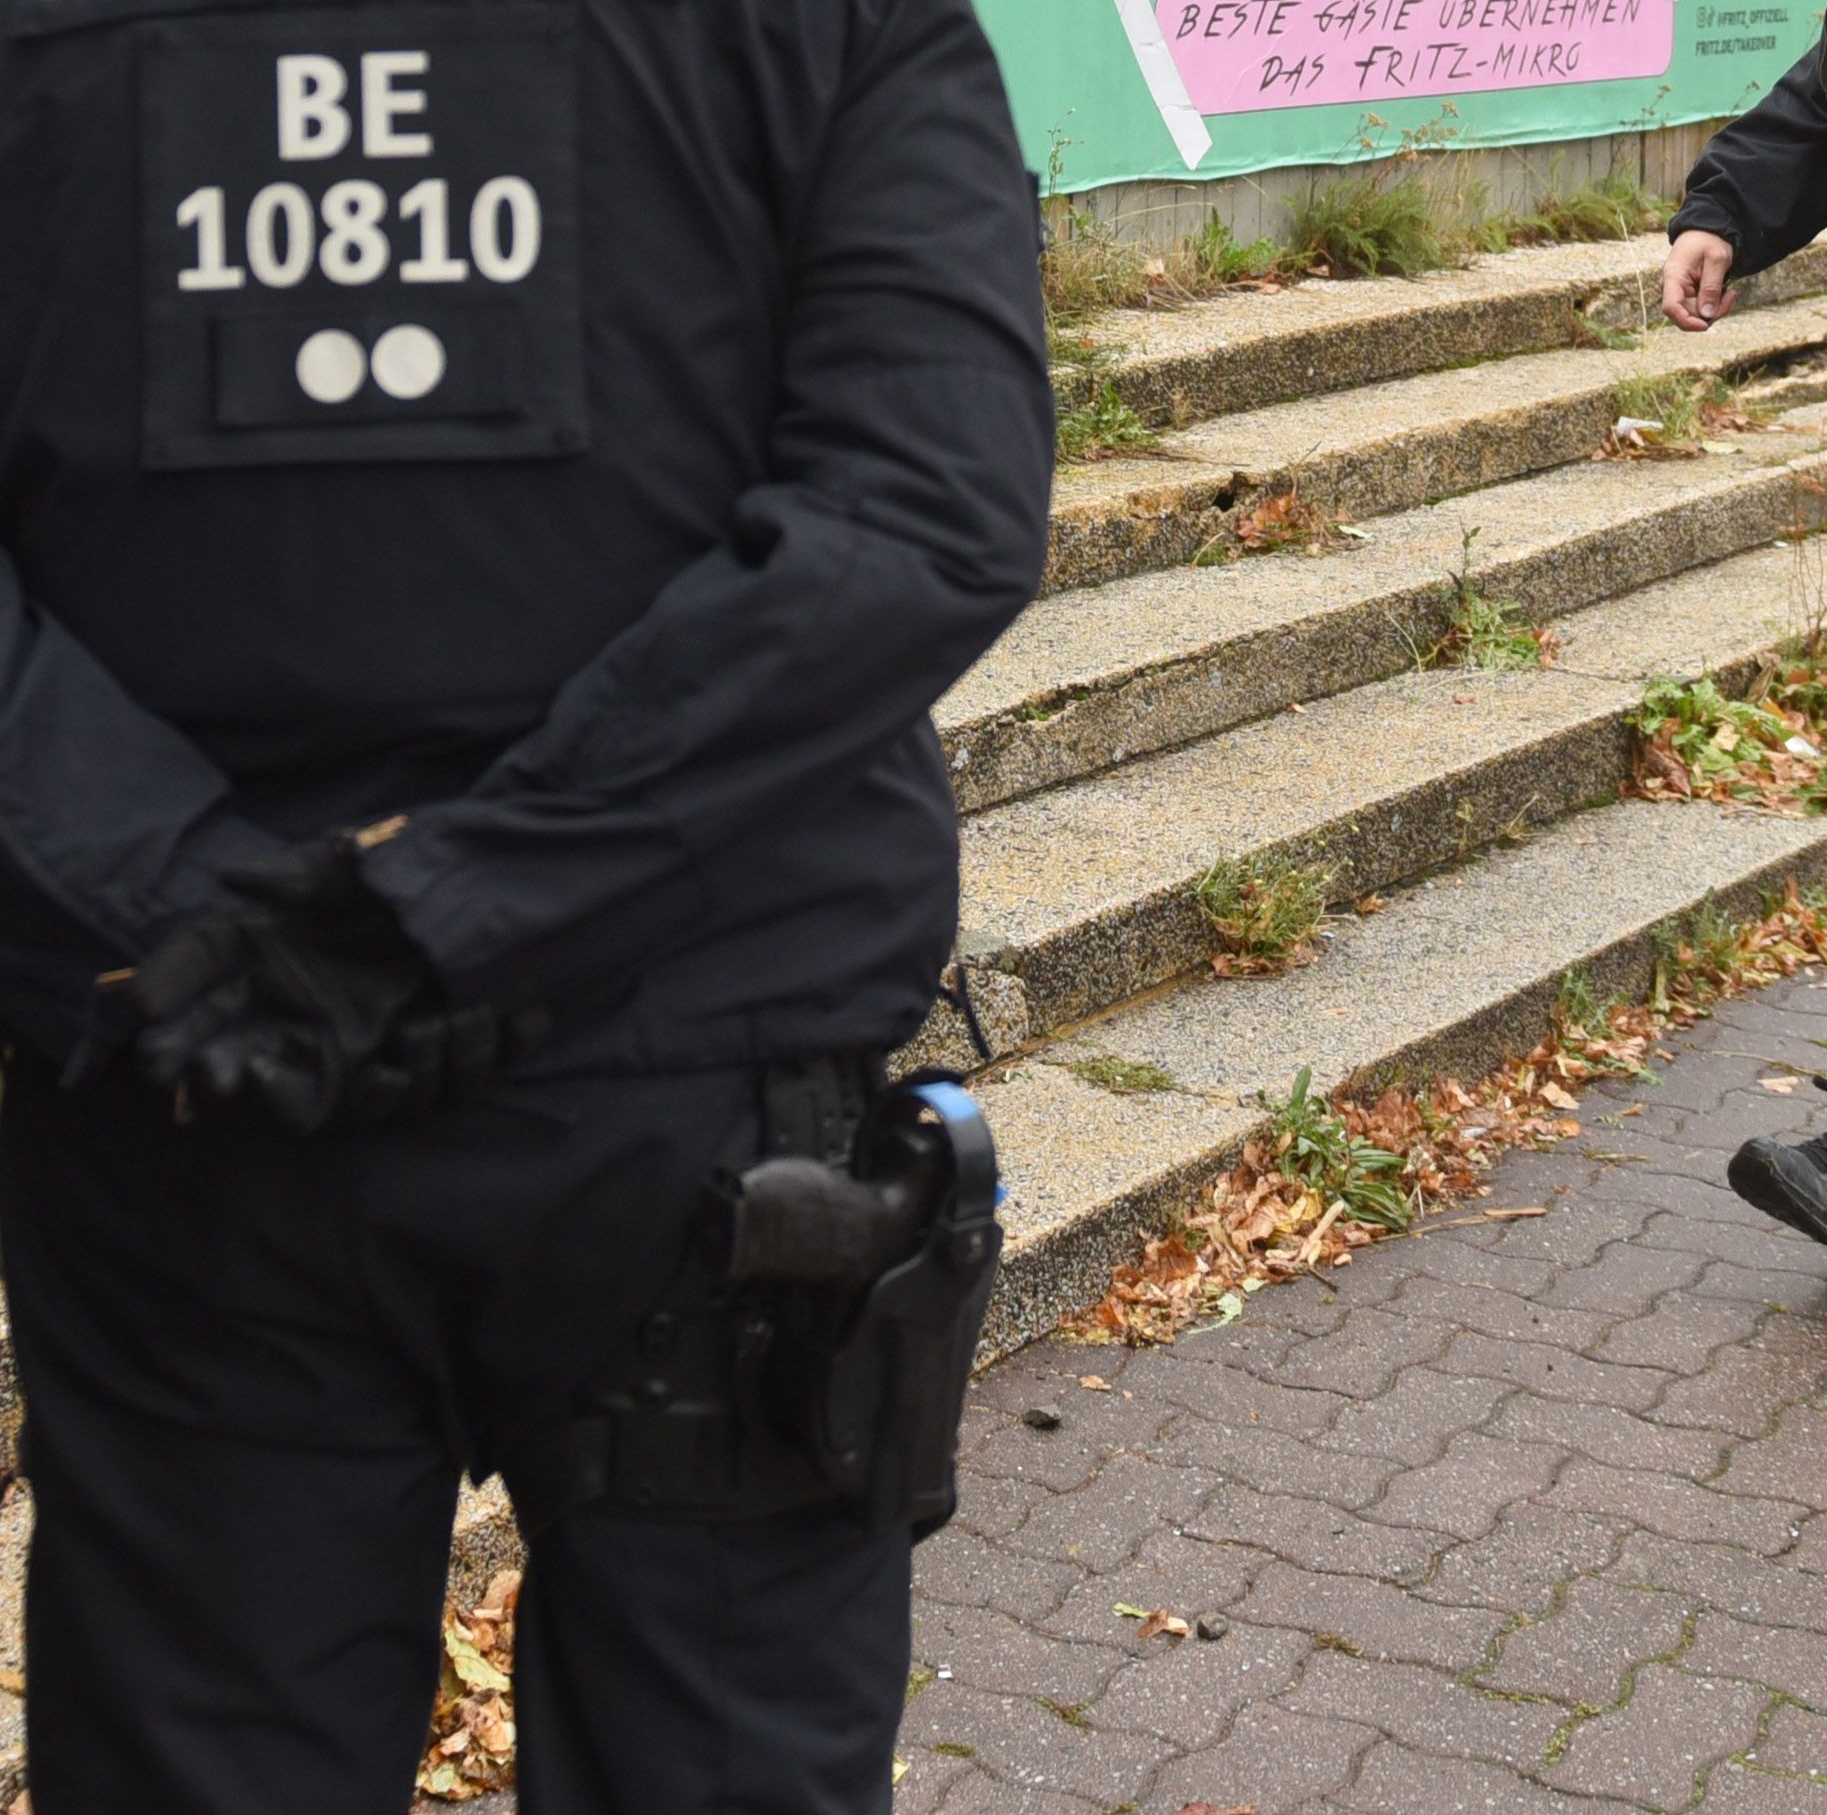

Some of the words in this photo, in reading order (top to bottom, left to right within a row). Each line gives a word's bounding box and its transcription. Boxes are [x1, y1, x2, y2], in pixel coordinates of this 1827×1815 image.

[275, 50, 434, 162] BE
[1259, 53, 1328, 97] DAS
[1354, 41, 1582, 92] FRITZ-MIKRO
[176, 175, 543, 291] 10810
